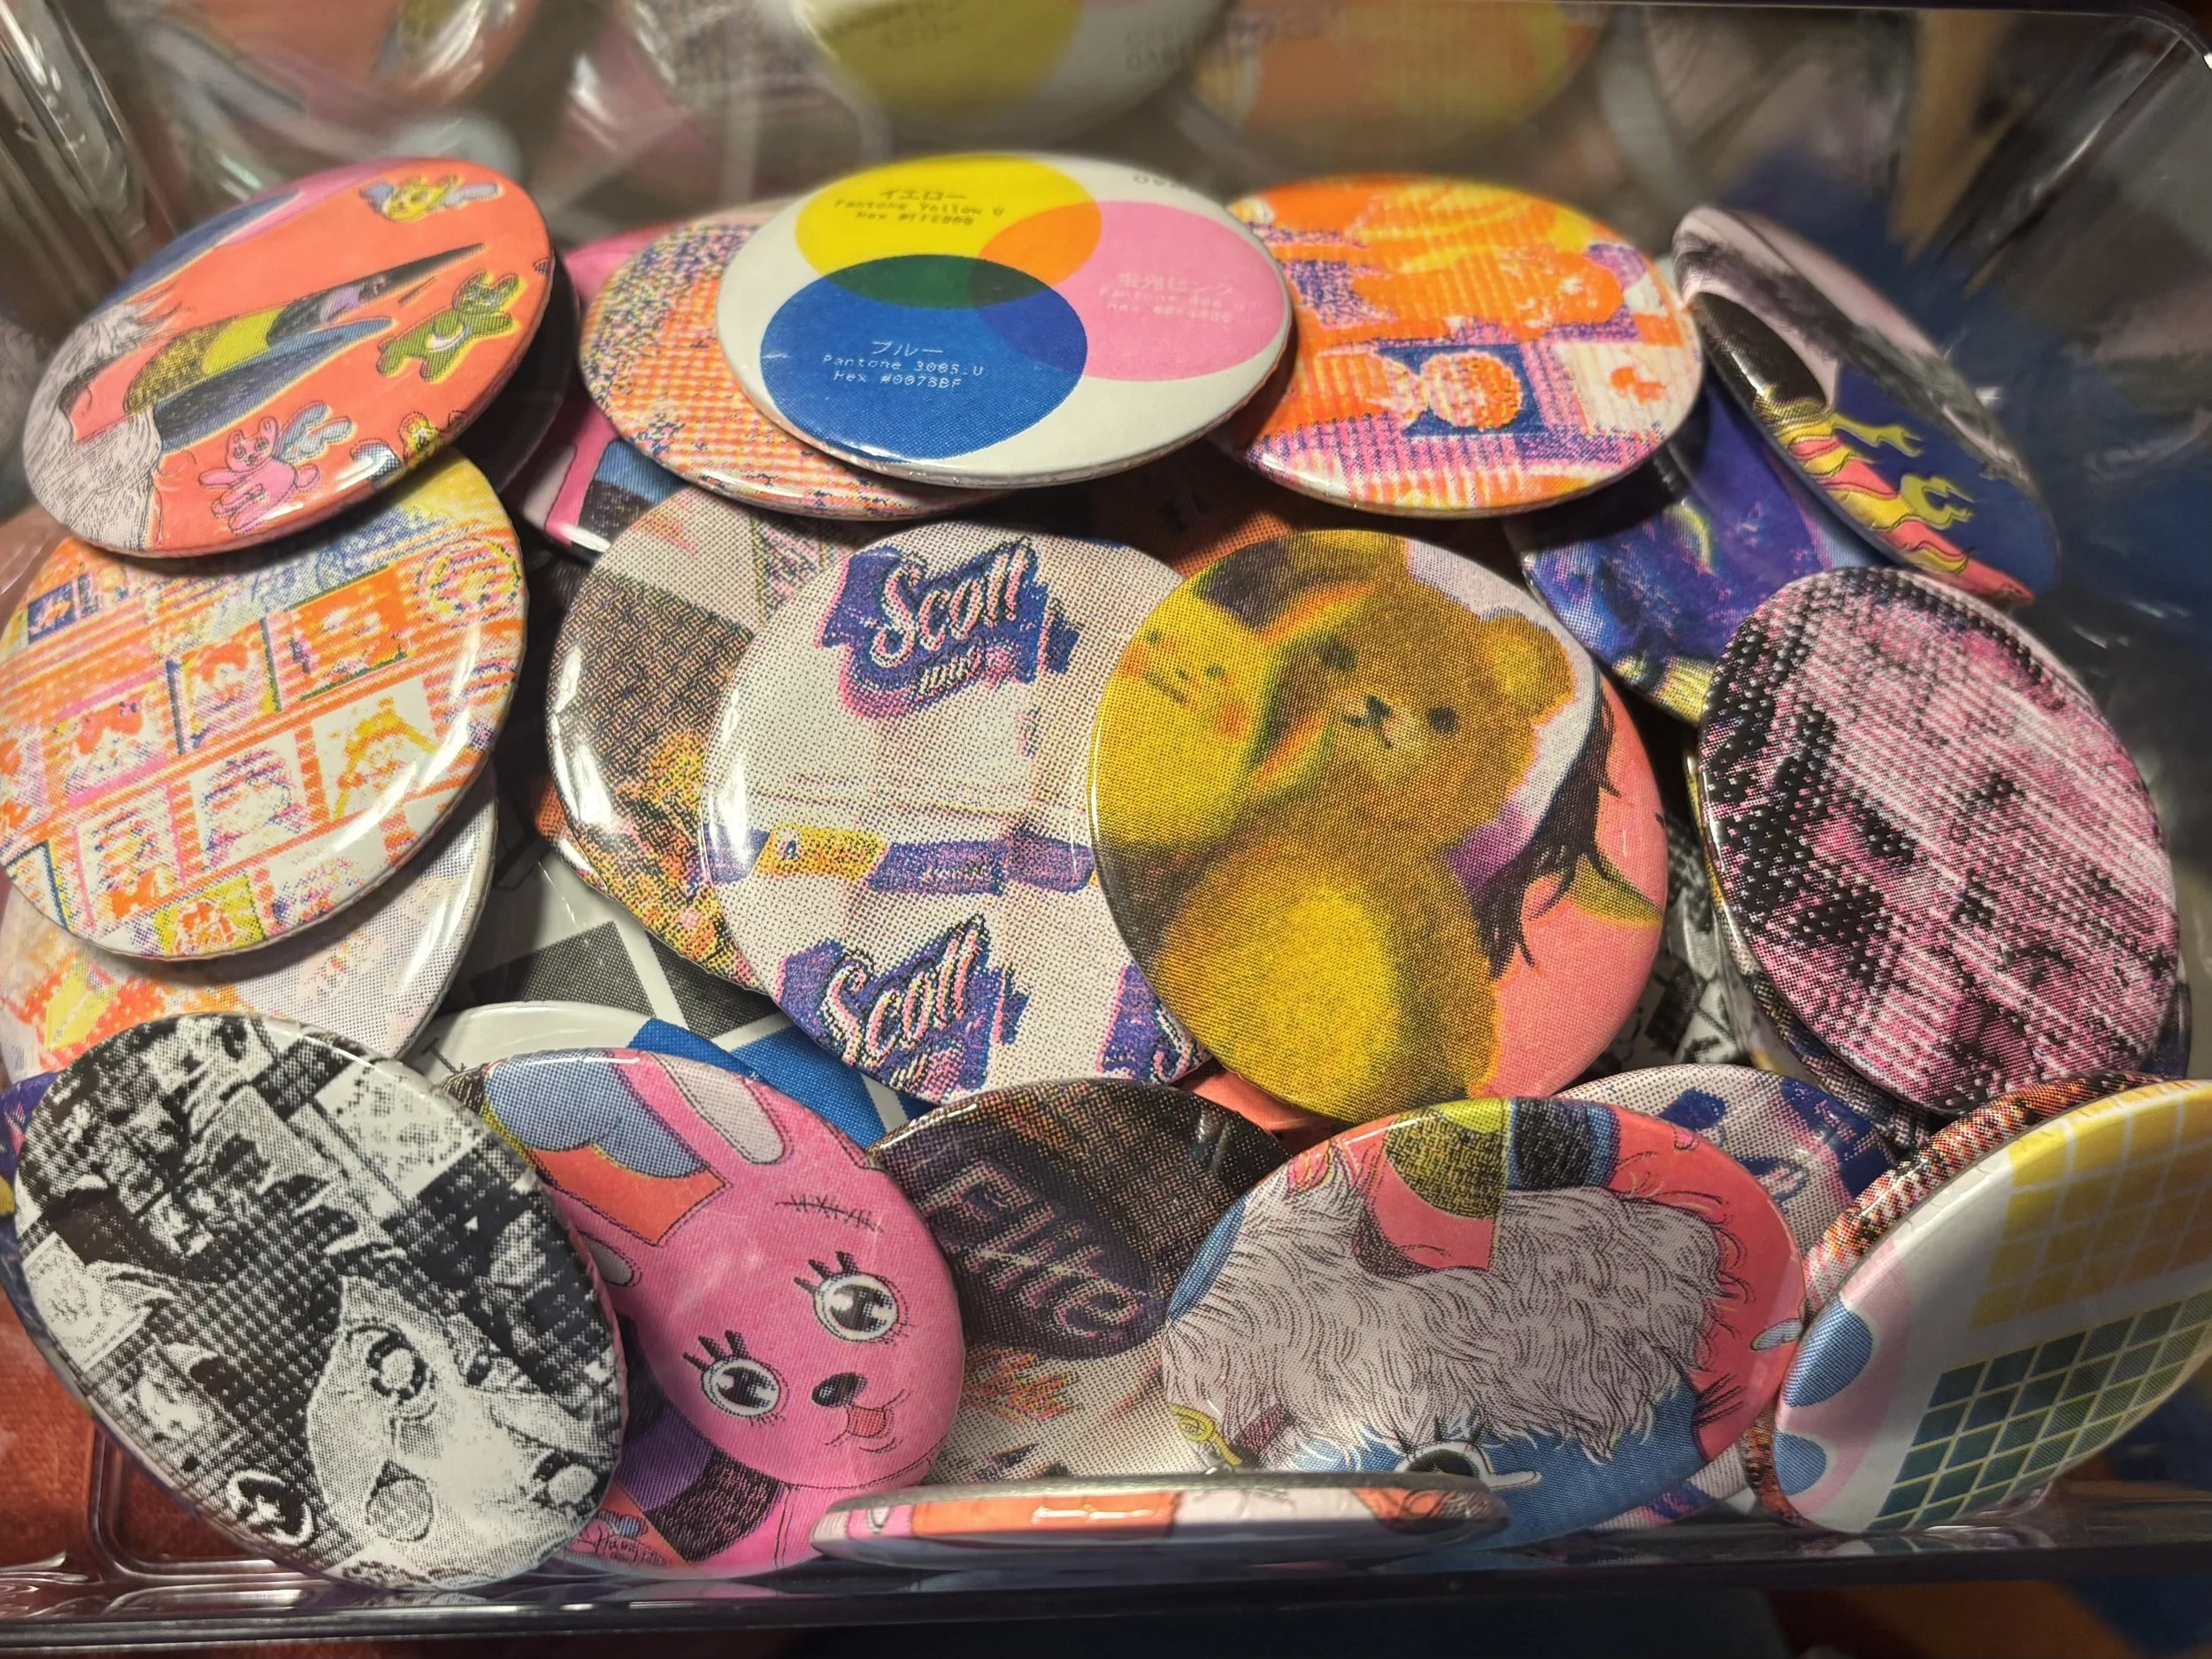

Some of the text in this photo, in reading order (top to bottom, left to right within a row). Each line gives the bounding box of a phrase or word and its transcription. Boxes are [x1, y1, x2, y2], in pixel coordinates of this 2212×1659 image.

[834, 198, 908, 211] Pantone
[919, 203, 984, 216] Yellow
[822, 354, 902, 370] Pantone
[833, 370, 868, 383] Hex
